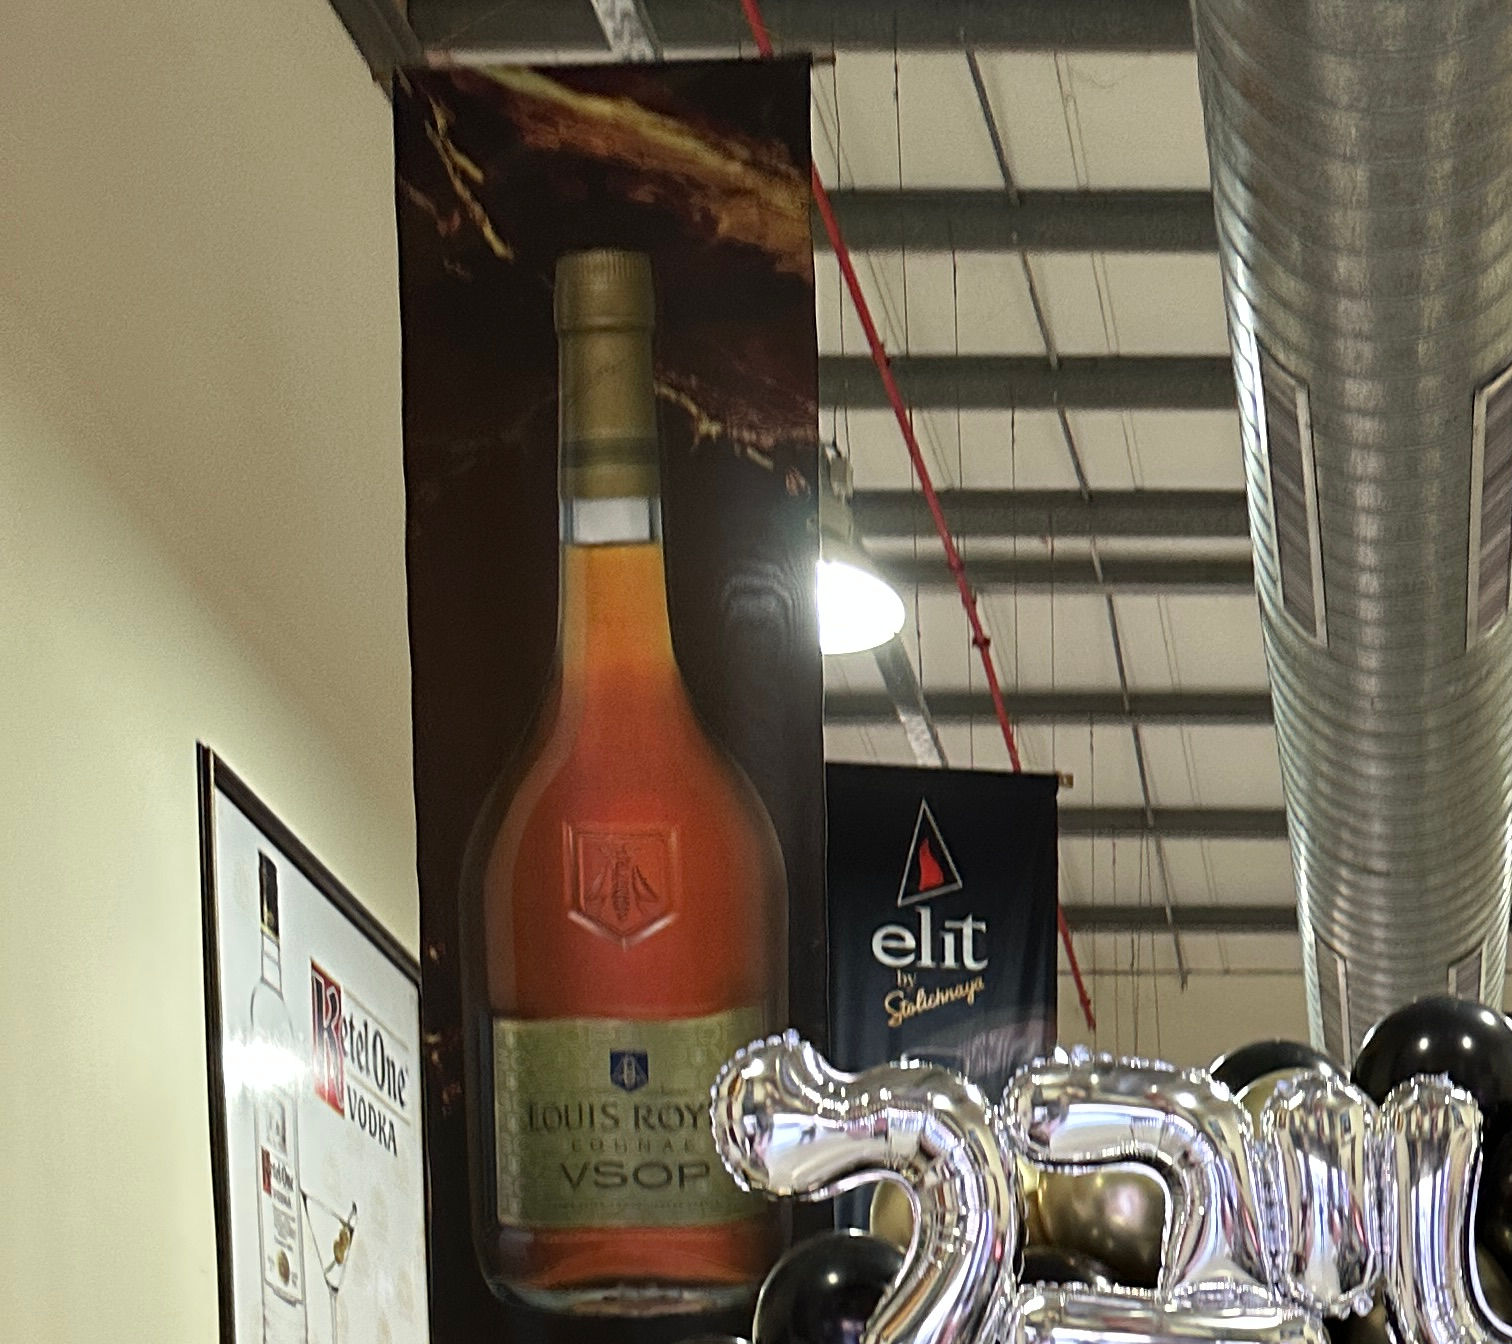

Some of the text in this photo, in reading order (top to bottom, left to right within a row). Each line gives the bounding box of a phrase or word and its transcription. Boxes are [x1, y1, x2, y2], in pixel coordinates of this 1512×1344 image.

[871, 905, 989, 972] elit
[884, 975, 986, 1028] Stolichnaya
[897, 969, 917, 988] by
[311, 965, 406, 1113] Ketel One
[346, 1083, 398, 1157] VODKA
[527, 1103, 712, 1131] LOUIS ROY
[560, 1160, 710, 1191] VSOP
